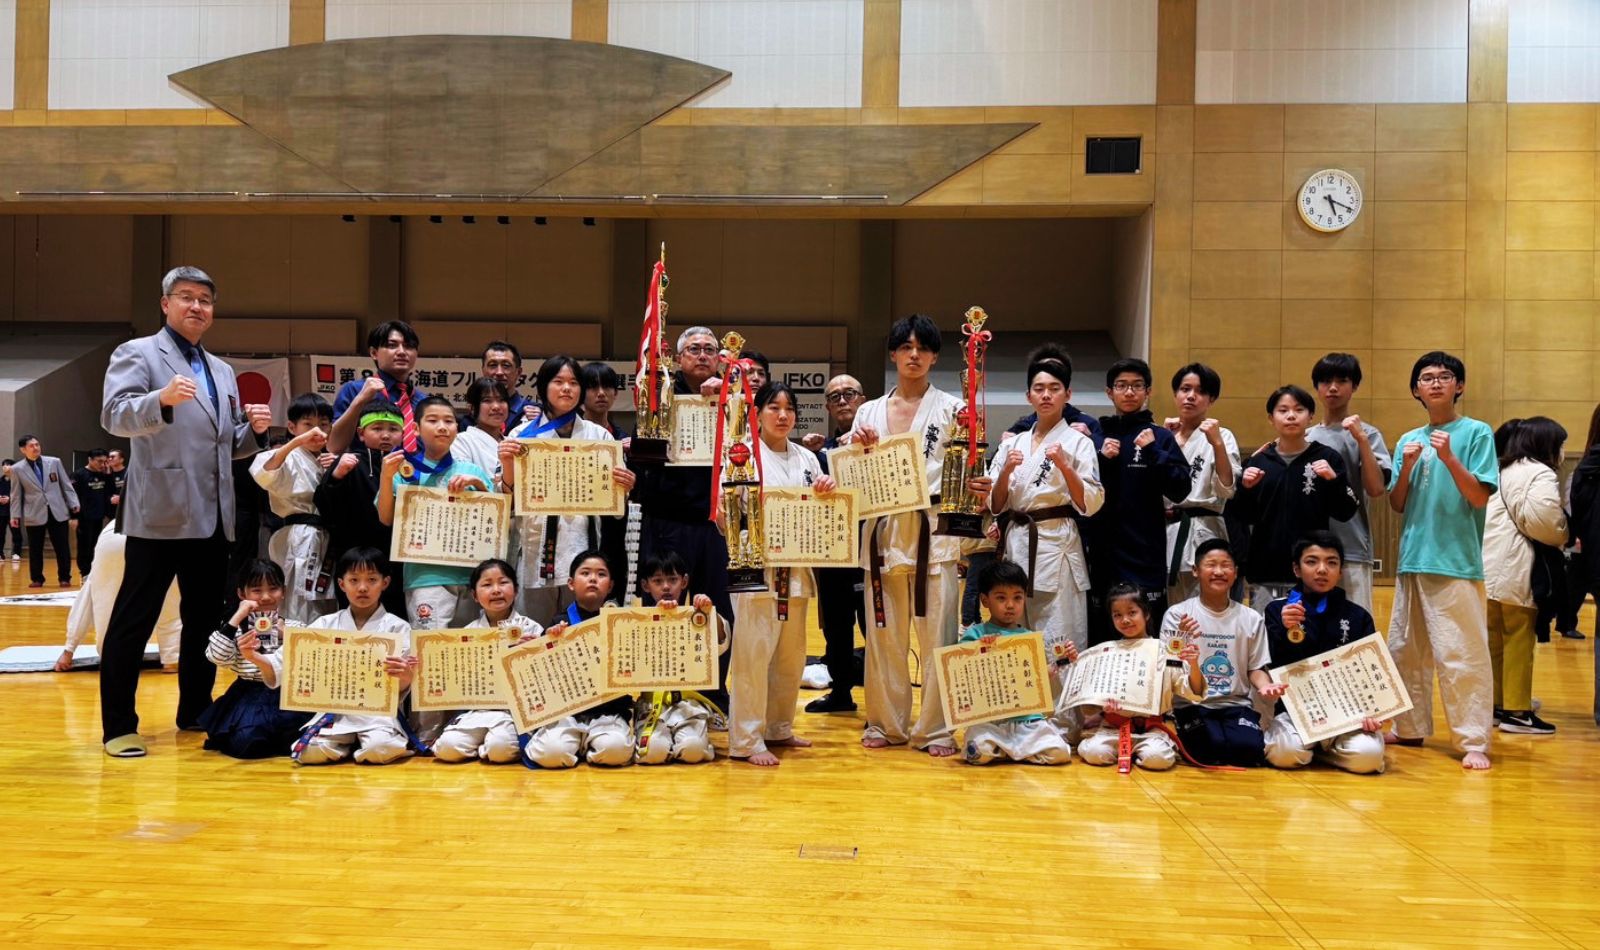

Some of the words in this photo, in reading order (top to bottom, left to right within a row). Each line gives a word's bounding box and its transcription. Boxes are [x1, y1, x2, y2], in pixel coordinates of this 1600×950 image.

[1327, 176, 1334, 184] 12
[1309, 186, 1316, 194] 10
[1346, 186, 1352, 194] 2
[1305, 197, 1311, 205] 9
[1349, 196, 1355, 204] 3
[1309, 207, 1314, 215] 8
[1317, 214, 1323, 222] 7
[1327, 217, 1333, 225] 6
[1337, 214, 1343, 222] 5
[1023, 659, 1033, 688] 表彰状
